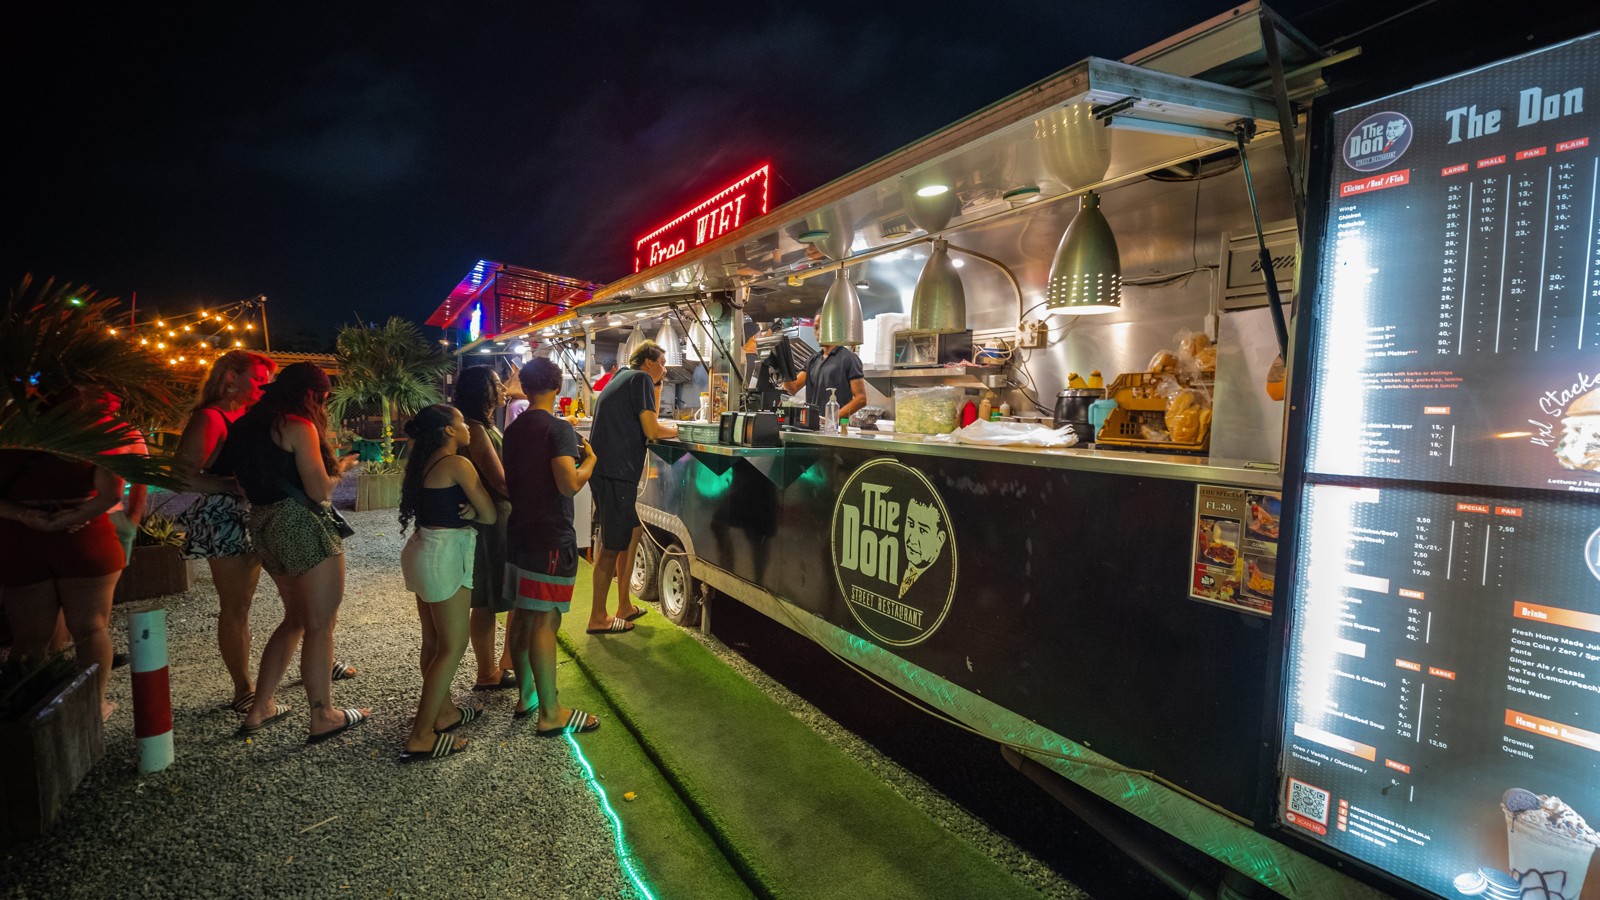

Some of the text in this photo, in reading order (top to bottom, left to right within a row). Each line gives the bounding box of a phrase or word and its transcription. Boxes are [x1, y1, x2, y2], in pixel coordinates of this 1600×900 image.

[1446, 87, 1583, 144] The Don
[1362, 122, 1383, 140] The
[1350, 136, 1383, 159] Don
[1560, 140, 1584, 150] PLAIN
[1479, 158, 1503, 167] SMALL
[1444, 166, 1465, 175] LARGE
[650, 194, 746, 266] Free WIFI
[862, 482, 900, 533] The
[1206, 501, 1237, 512] FL.20,-
[840, 504, 899, 586] Don
[852, 588, 922, 627] STREET RESTAURANT
[1522, 608, 1547, 619] Drinks
[1512, 628, 1533, 639] Fresh
[1535, 633, 1559, 643] Home
[1561, 638, 1584, 648] Made
[1510, 647, 1532, 657] Fanta
[1511, 638, 1531, 648] Coca
[1532, 642, 1550, 651] Cola
[1558, 648, 1577, 657] Zero
[1431, 669, 1452, 678] LARGE
[1510, 657, 1585, 679] Ginger Ale Cassis
[1522, 668, 1536, 677] Tea
[1508, 675, 1530, 686] Water
[1507, 685, 1551, 701] Soda Water
[1370, 720, 1385, 730] Soup
[1398, 721, 1411, 729] 7,50
[1397, 729, 1410, 737] 7,50
[1429, 739, 1447, 748] 12,50
[1504, 736, 1534, 750] Brownie
[1292, 751, 1321, 767] Strawberry
[1503, 745, 1534, 760] Quesillo
[1311, 748, 1329, 761] Vanilla
[1334, 758, 1363, 774] Chocolate
